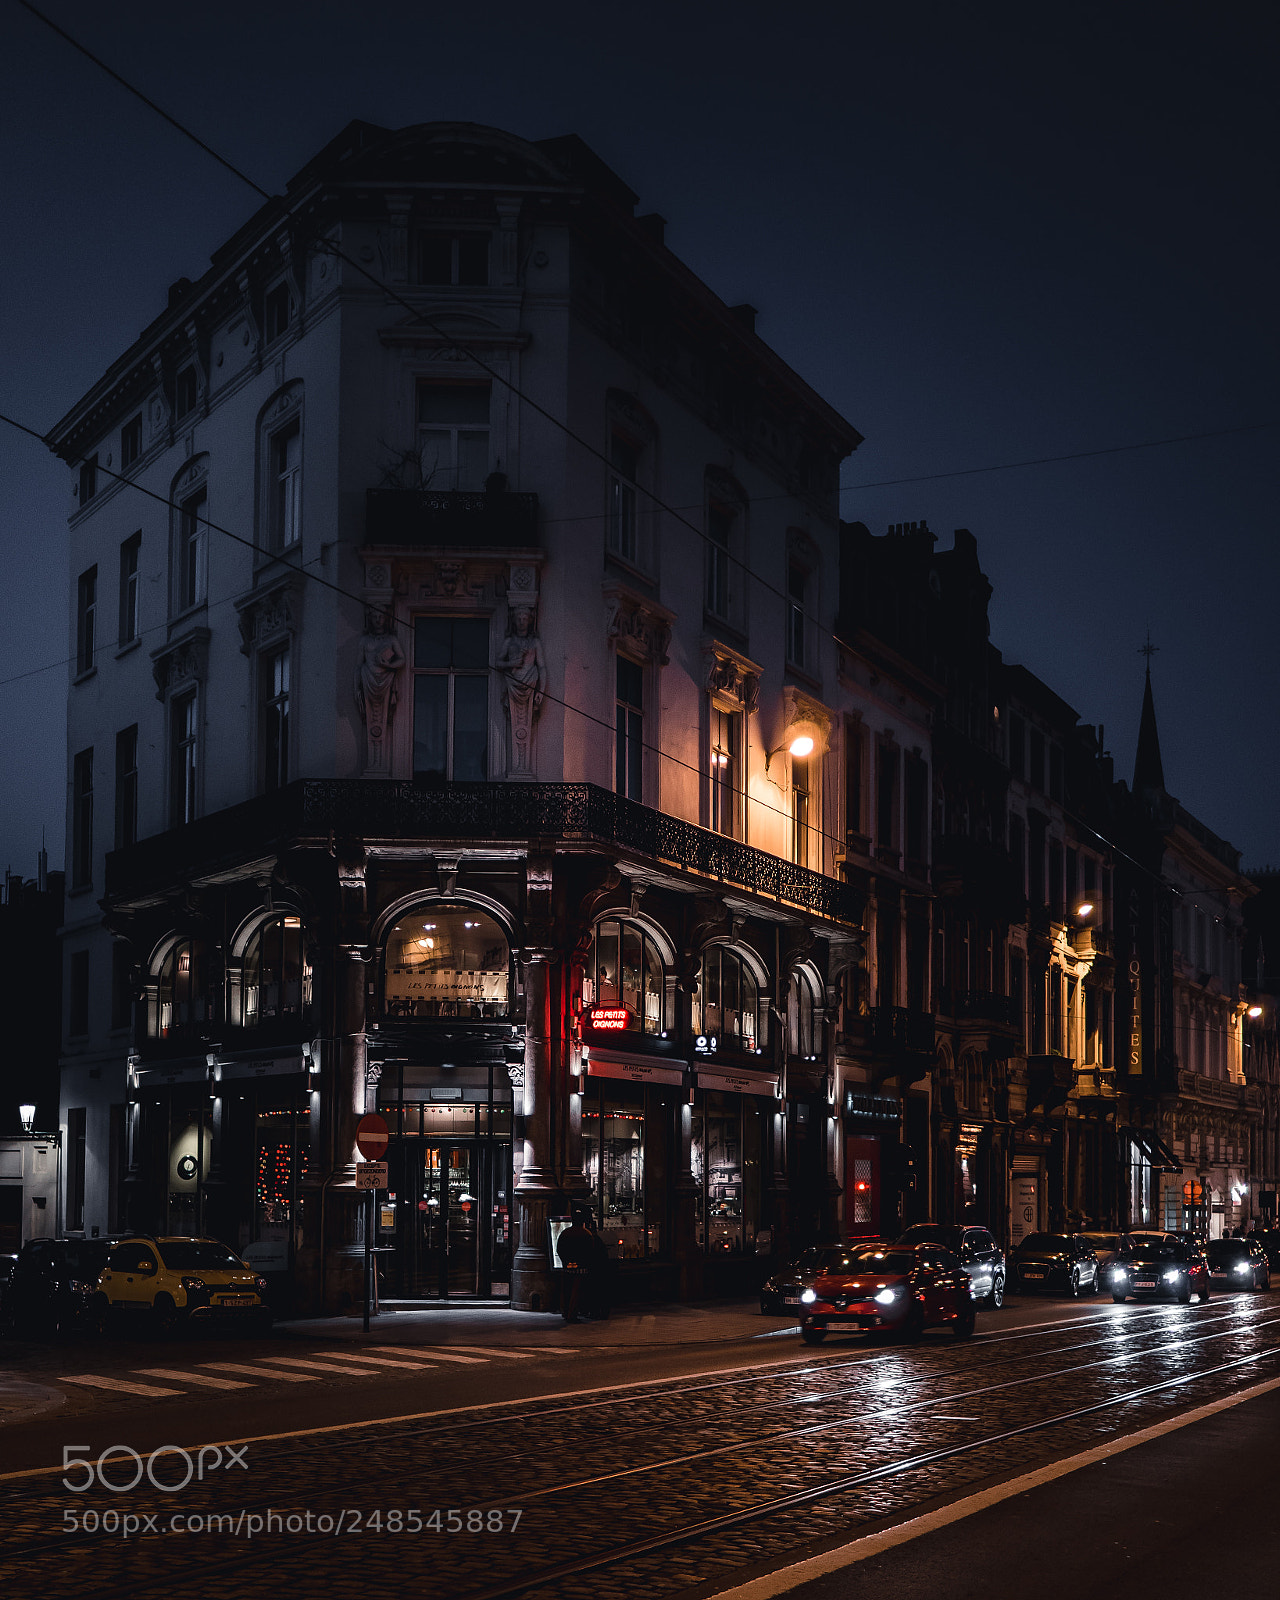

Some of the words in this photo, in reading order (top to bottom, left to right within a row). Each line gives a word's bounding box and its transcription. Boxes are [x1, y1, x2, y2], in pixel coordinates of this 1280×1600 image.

[591, 1010, 604, 1019] LES
[604, 1010, 626, 1019] PETITS
[593, 1020, 624, 1029] OIGNONS
